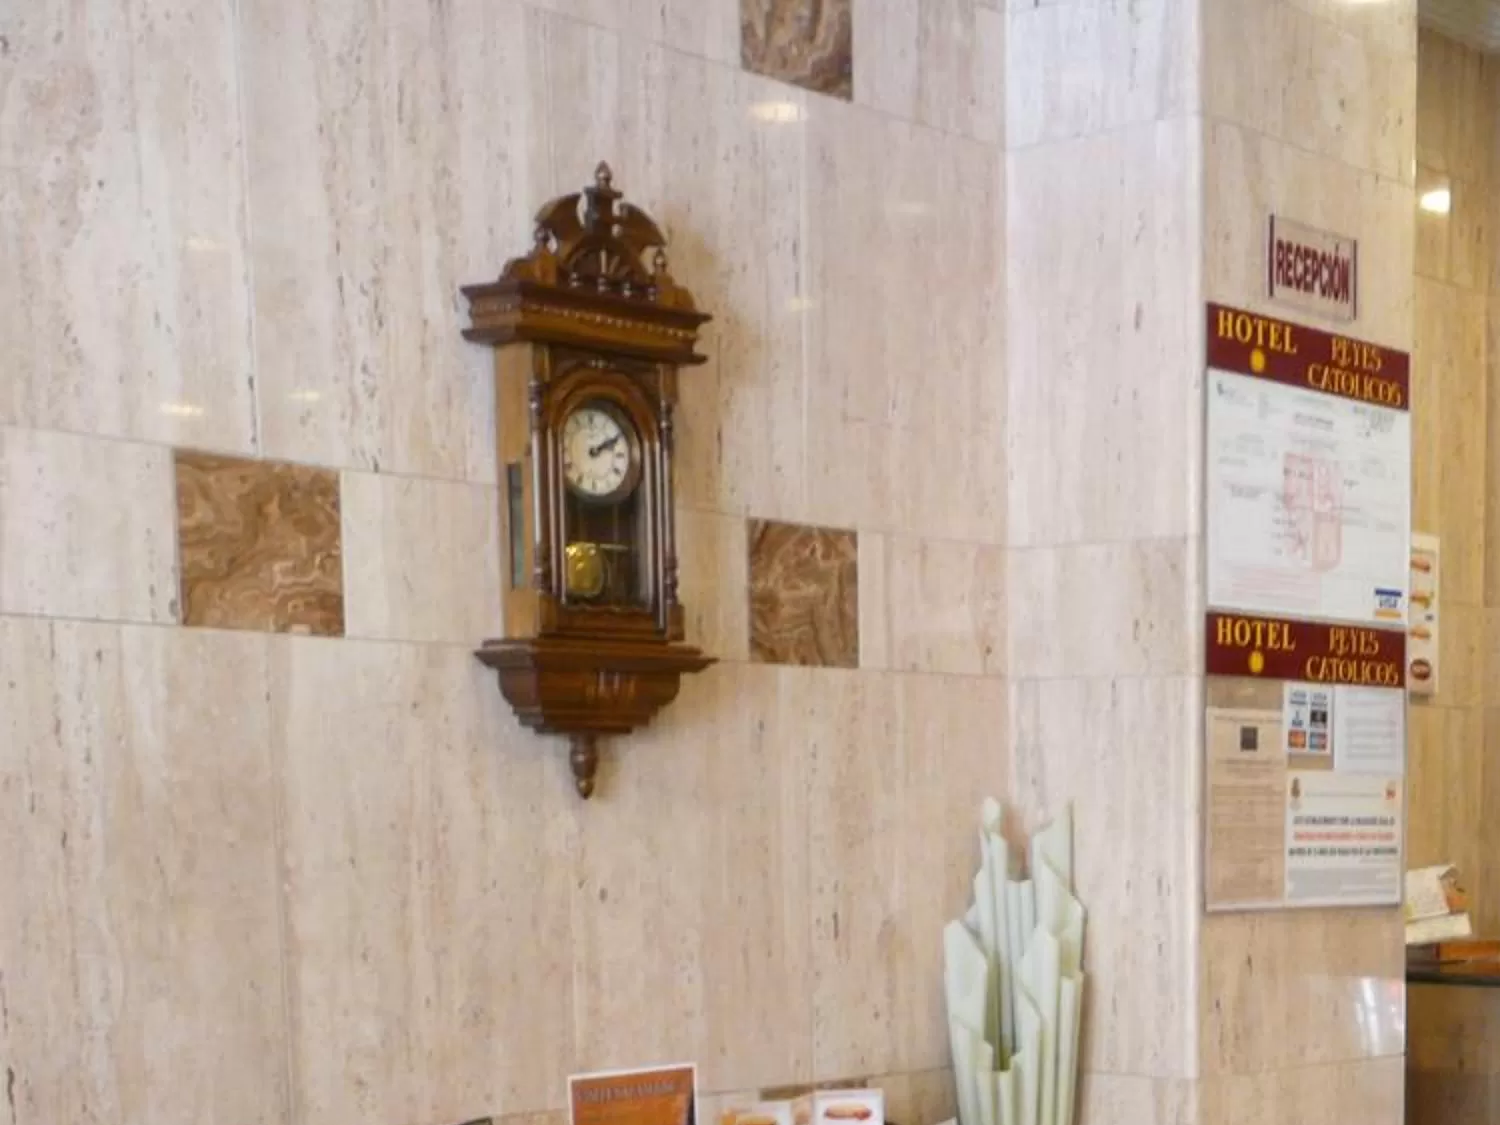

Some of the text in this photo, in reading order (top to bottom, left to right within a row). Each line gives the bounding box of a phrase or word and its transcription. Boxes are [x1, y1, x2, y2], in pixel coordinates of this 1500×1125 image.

[1275, 239, 1350, 304] RECEPCIÓN
[1217, 308, 1297, 354] HOTEL
[1331, 335, 1382, 372] REYES
[1215, 616, 1297, 651] HOTEL
[1328, 626, 1380, 655] REYES
